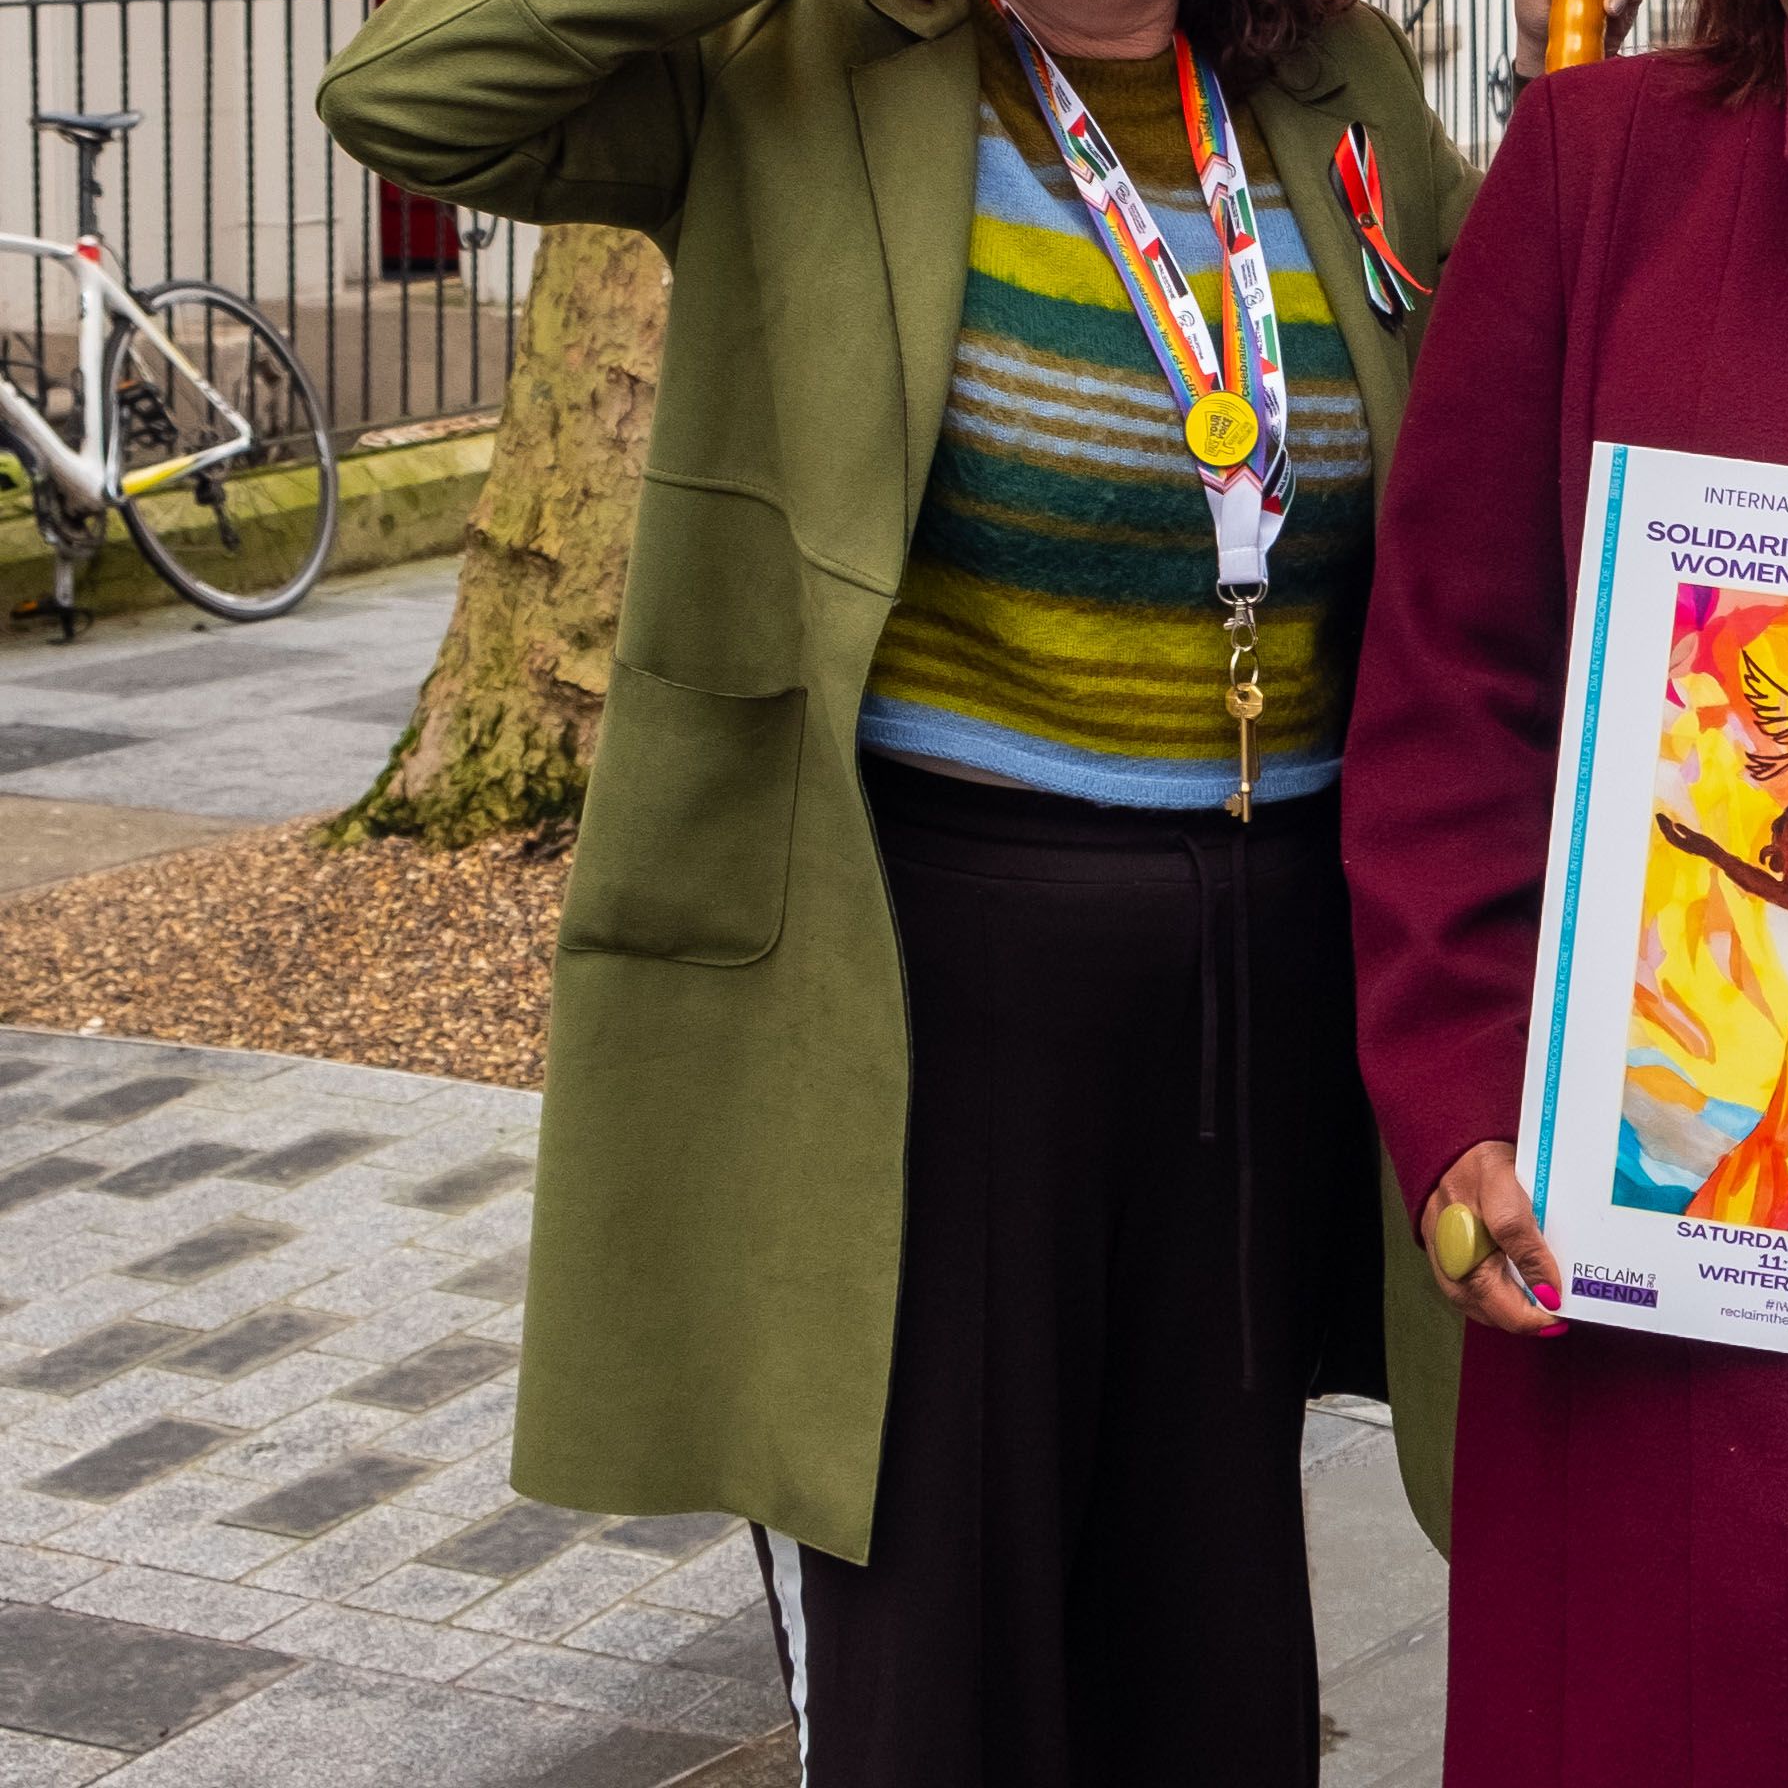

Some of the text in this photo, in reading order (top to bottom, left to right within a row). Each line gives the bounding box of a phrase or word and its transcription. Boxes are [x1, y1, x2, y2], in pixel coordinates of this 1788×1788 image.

[1604, 511, 1616, 548] MUJER
[1602, 551, 1612, 564] LA
[1600, 568, 1610, 582] DE
[1579, 745, 1591, 778] DELLA
[1572, 1278, 1657, 1308] AGENDA
